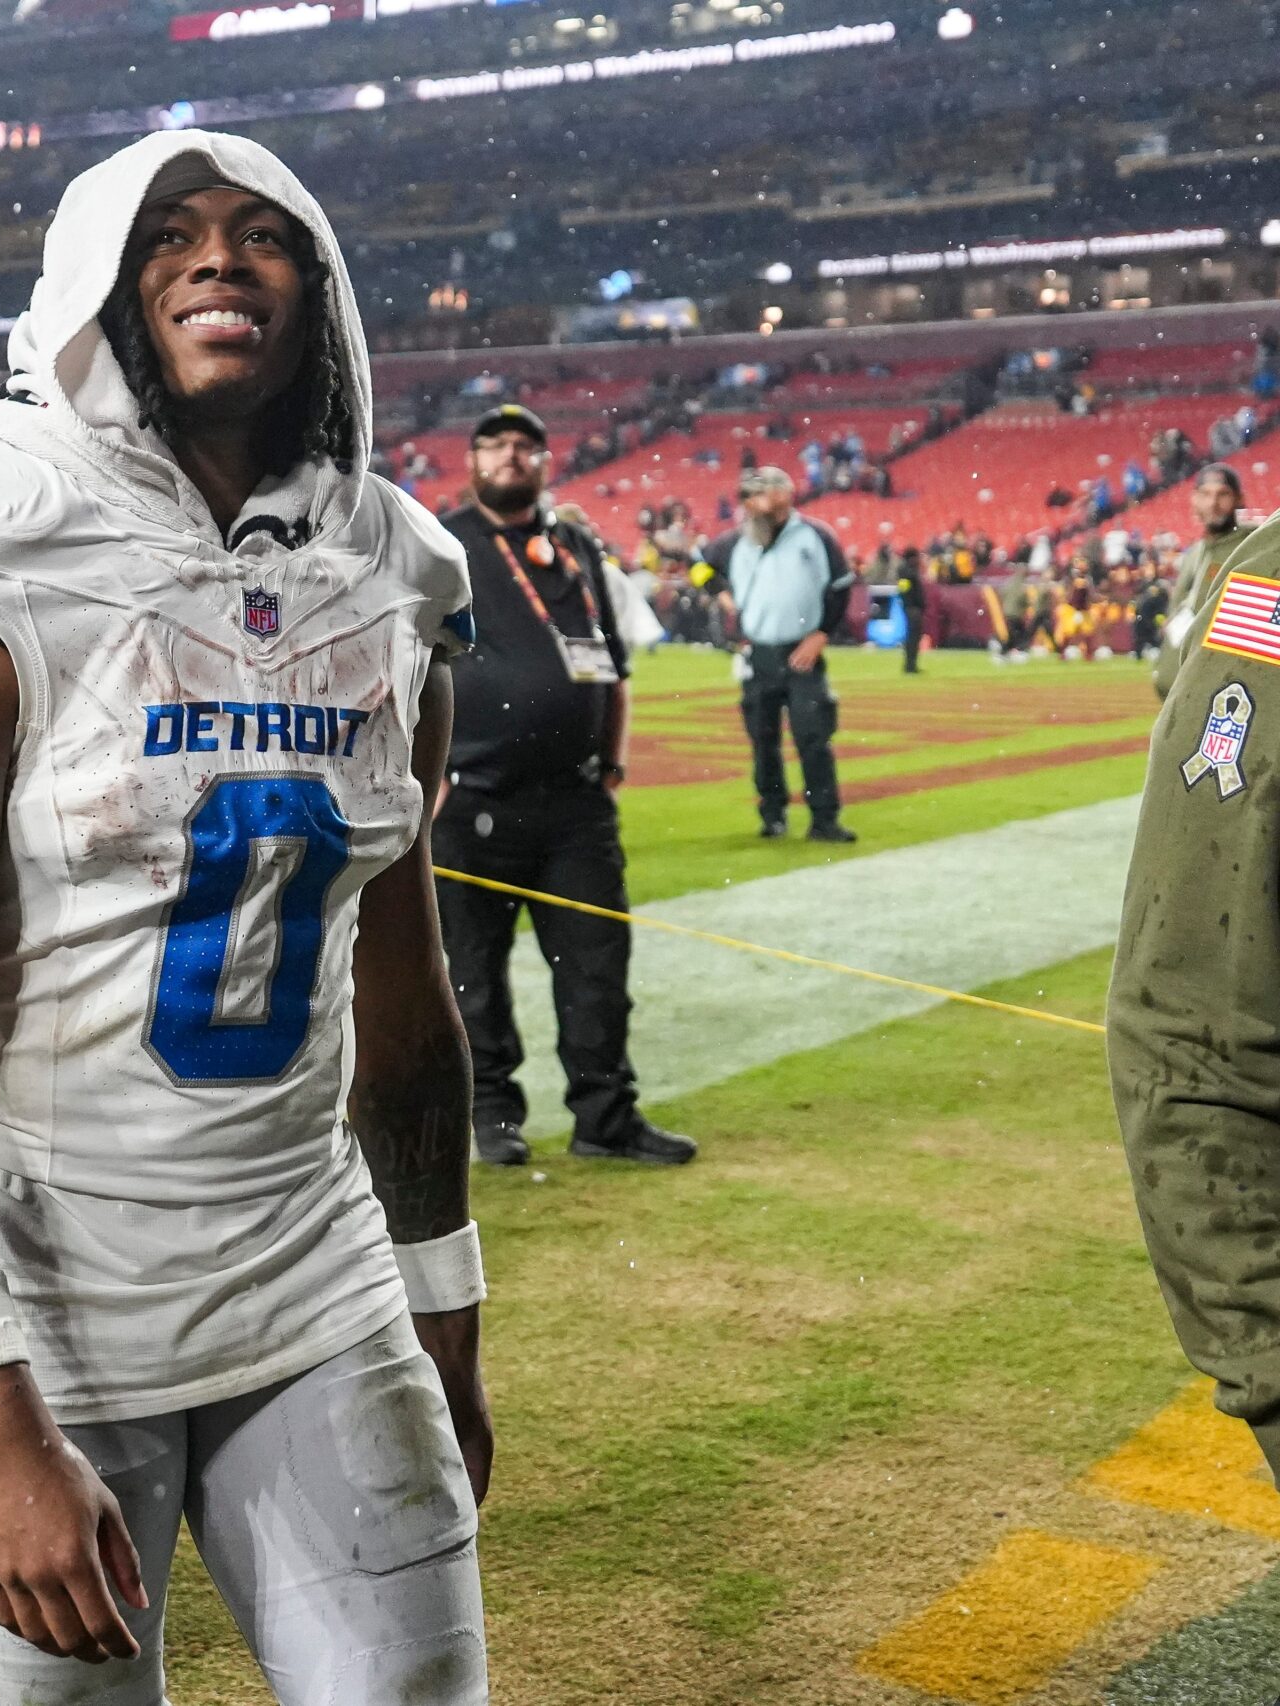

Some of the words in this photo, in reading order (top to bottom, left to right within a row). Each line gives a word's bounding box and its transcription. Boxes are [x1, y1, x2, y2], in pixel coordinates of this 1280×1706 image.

[247, 607, 277, 631] NFL
[142, 701, 370, 757] DETROIT
[1205, 734, 1234, 760] NFL
[141, 769, 352, 1088] 0
